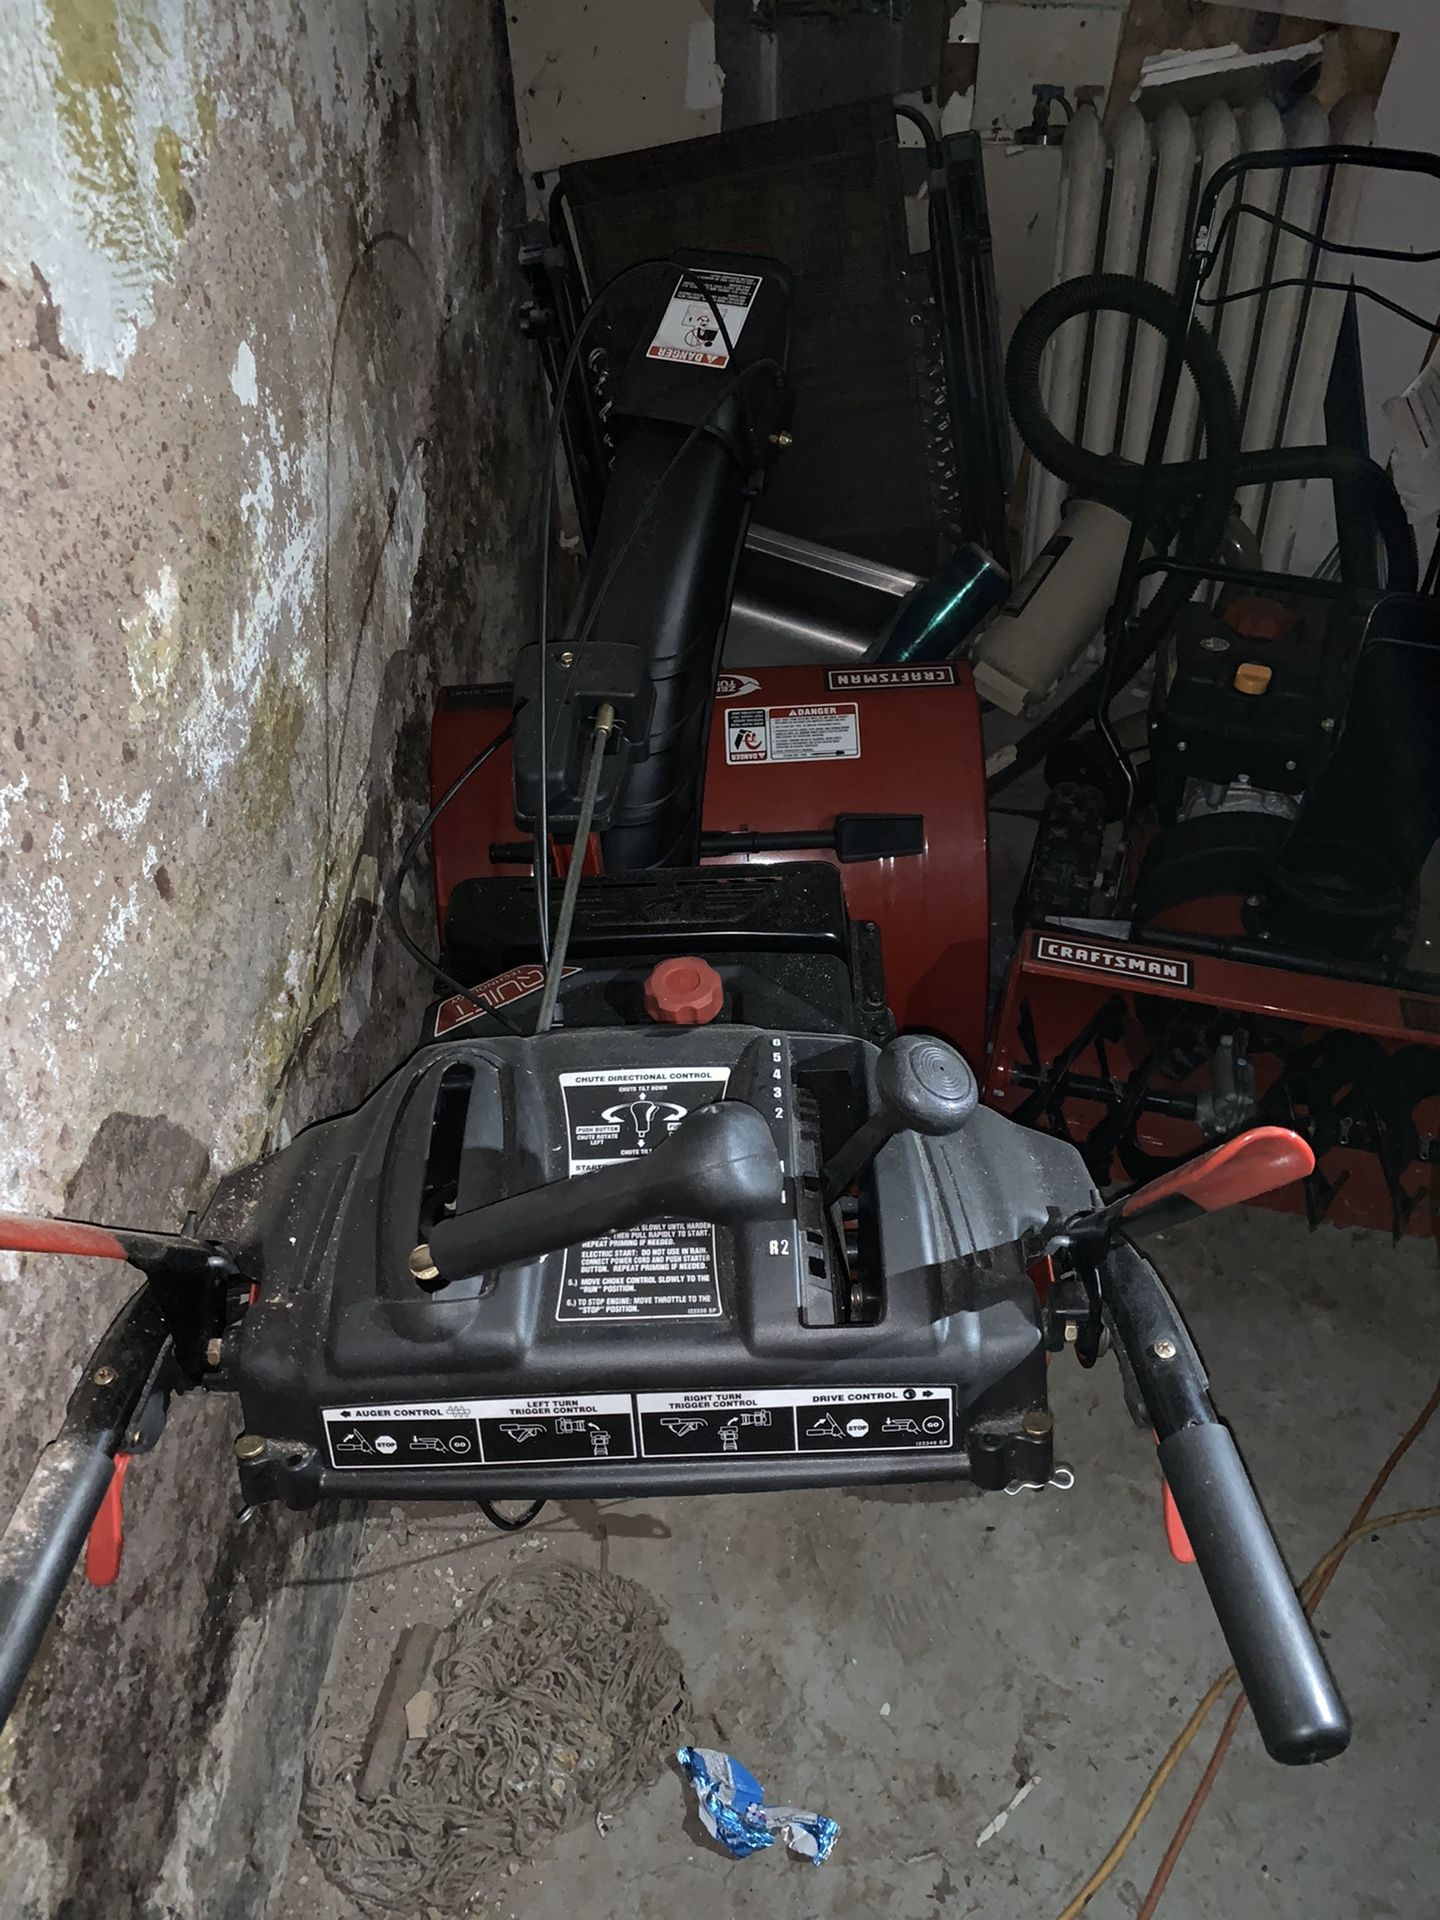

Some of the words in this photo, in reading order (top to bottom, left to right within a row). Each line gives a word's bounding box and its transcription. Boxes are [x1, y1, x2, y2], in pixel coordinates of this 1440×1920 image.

[657, 348, 703, 362] DANGER
[837, 671, 945, 686] CRAFTSMAN
[797, 707, 837, 716] DANGER
[1048, 944, 1177, 978] CRAFTSMAN
[773, 1039, 781, 1047] 6
[773, 1053, 782, 1062] 5
[608, 1073, 667, 1082] DIRECTIONAL
[669, 1071, 712, 1079] CONTROL
[772, 1070, 782, 1080] 4
[773, 1087, 782, 1098] 3
[775, 1108, 784, 1118] 2
[631, 1231, 647, 1239] PULL
[648, 1230, 676, 1238] RAPIDLY
[687, 1229, 711, 1237] START.
[609, 1239, 638, 1247] PRIMING
[639, 1238, 646, 1246] IF
[647, 1238, 676, 1246] NEEDED.
[769, 1240, 790, 1255] R2
[581, 1250, 613, 1258] ELECTRIC
[614, 1249, 638, 1257] START:
[641, 1248, 651, 1256] DO
[581, 1258, 609, 1266] CONNECT
[610, 1257, 632, 1265] POWER
[633, 1256, 651, 1264] CORD
[683, 1254, 710, 1262] STARTER
[581, 1266, 609, 1274] BUTTON.
[679, 1262, 707, 1270] NEEDED.
[580, 1278, 600, 1286] MOVE
[602, 1277, 624, 1285] CHOKE
[626, 1276, 656, 1284] CONTROL
[658, 1275, 685, 1283] SLOWLY
[697, 1274, 710, 1282] THE
[578, 1298, 587, 1306] TO
[587, 1298, 605, 1306] STOP
[606, 1297, 632, 1305] ENGINE:
[633, 1296, 653, 1304] MOVE
[654, 1295, 687, 1303] THROTTLE
[688, 1295, 698, 1303] TO
[605, 1305, 640, 1313] POSITION.
[684, 1394, 714, 1402] RIGHT
[716, 1393, 742, 1401] TURN
[812, 1394, 845, 1403] DRIVE
[847, 1392, 898, 1401] CONTROL
[552, 1399, 578, 1407] TURN
[669, 1401, 711, 1409] TRIGGER
[713, 1399, 758, 1408] CONTROL
[355, 1409, 392, 1418] AUGER
[394, 1408, 443, 1417] CONTROL
[509, 1406, 551, 1415] TRIGGER
[553, 1405, 598, 1413] CONTROL
[848, 1424, 867, 1432] STOP
[376, 1441, 395, 1449] STOP
